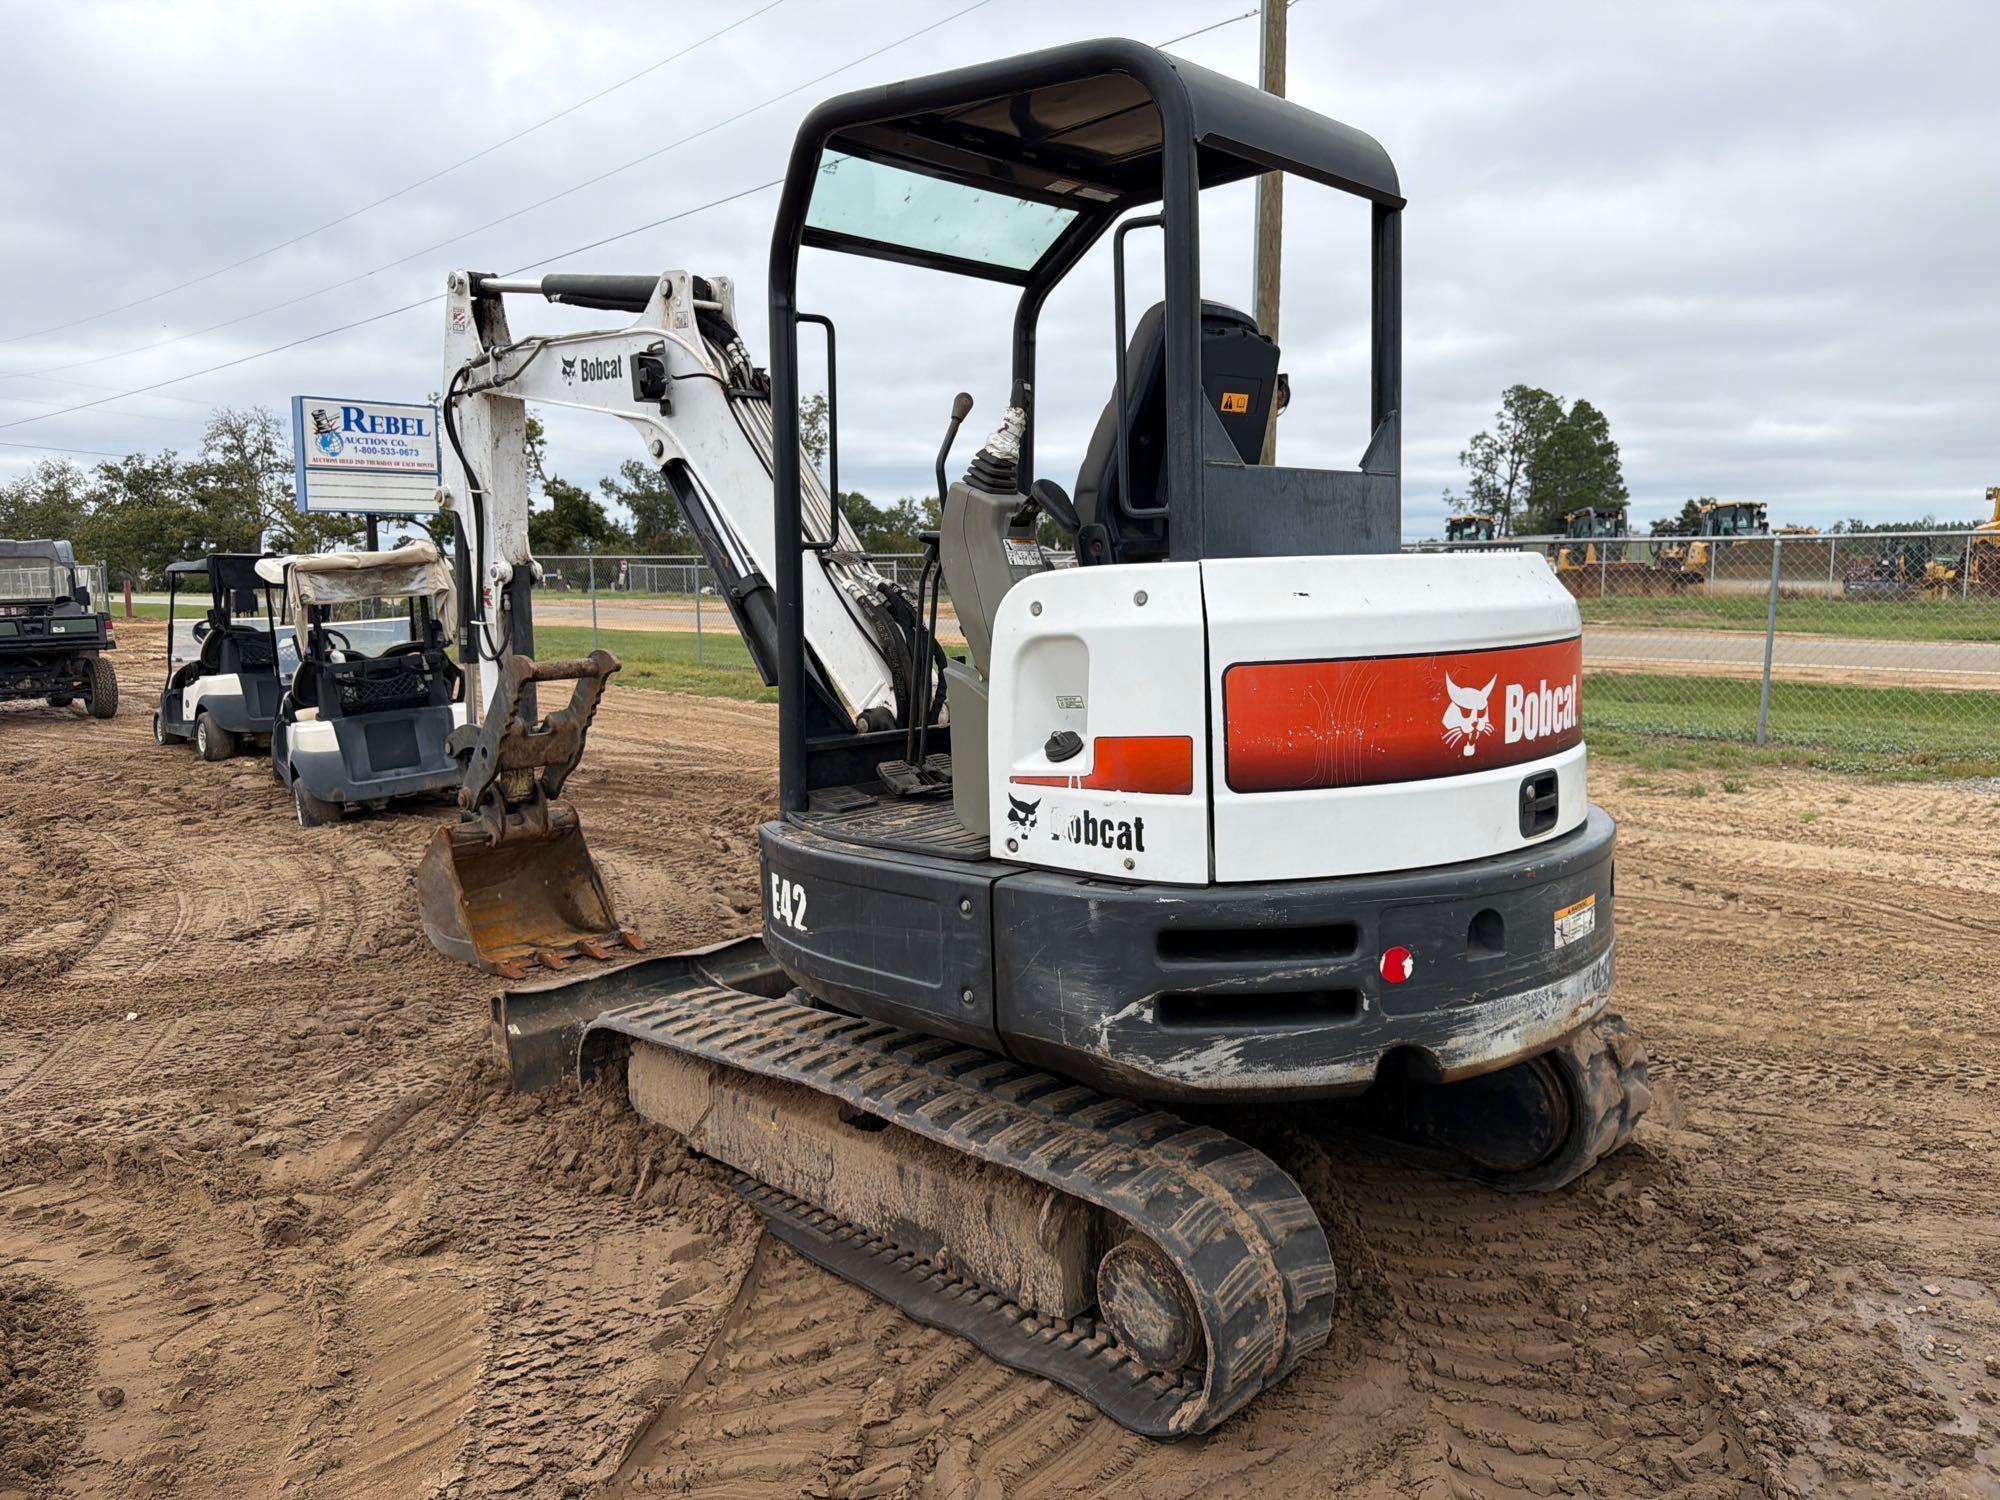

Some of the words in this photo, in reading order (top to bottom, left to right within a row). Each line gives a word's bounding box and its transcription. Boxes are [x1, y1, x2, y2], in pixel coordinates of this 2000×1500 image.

[581, 355, 623, 382] Bobcat
[341, 406, 431, 437] REBEL
[344, 437, 388, 446] AUCTION
[391, 439, 408, 447] CO.
[354, 446, 419, 457] 1-800-533-0673
[1504, 674, 1577, 745] Bobcat
[1051, 807, 1145, 852] obcat
[771, 871, 808, 931] E42
